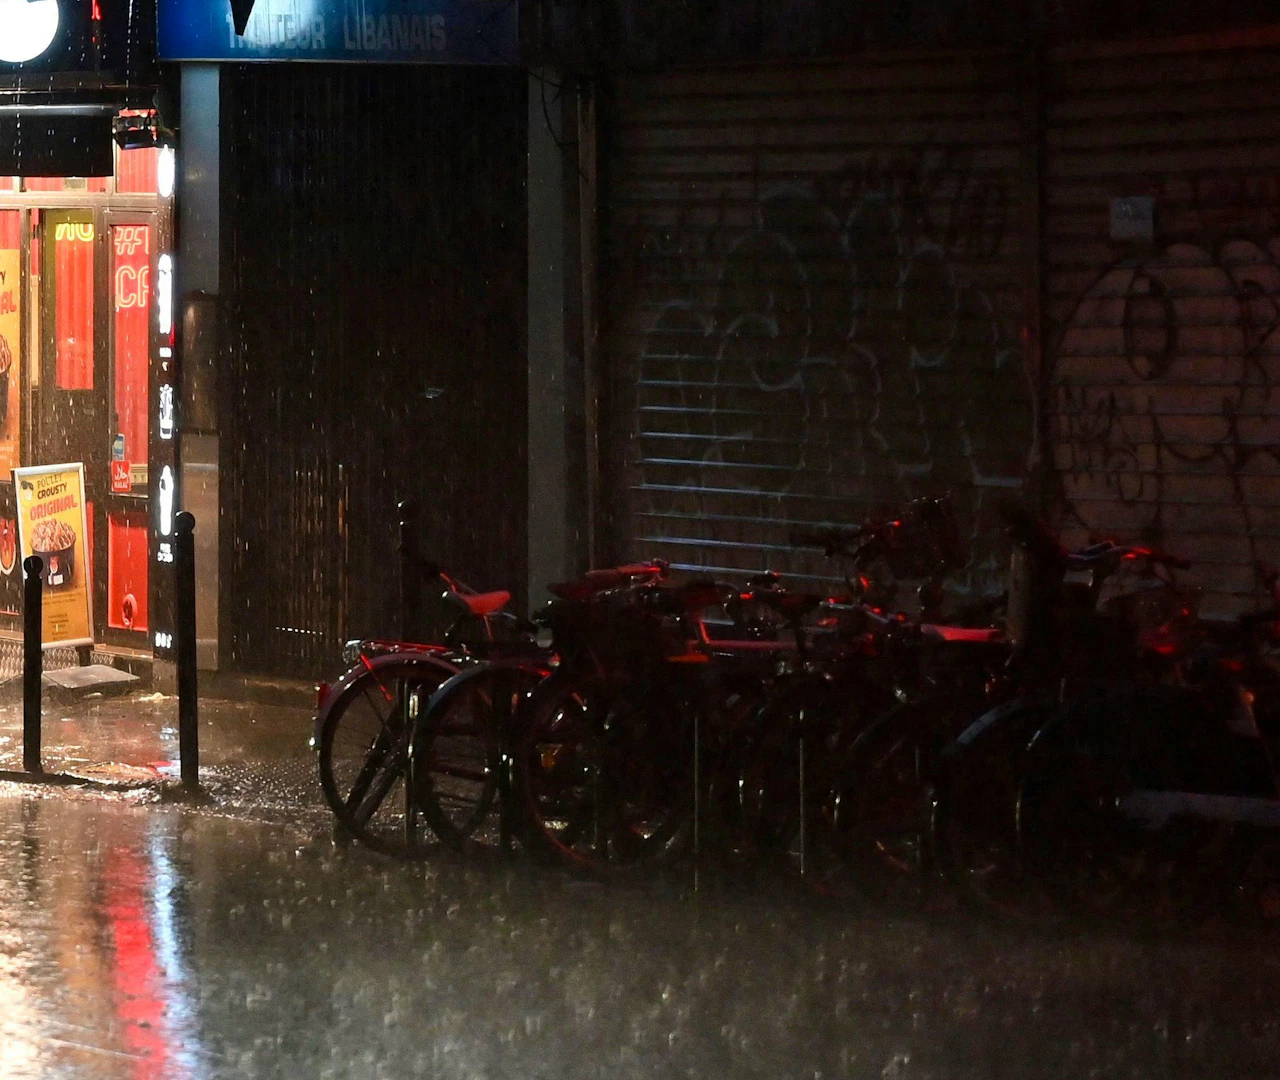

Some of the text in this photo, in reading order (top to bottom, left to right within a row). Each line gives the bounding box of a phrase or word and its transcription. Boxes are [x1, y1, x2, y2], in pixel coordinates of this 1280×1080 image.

[344, 14, 447, 52] LIBANAIS
[37, 482, 68, 500] CROUSTY
[29, 493, 78, 522] ORIGINAL
